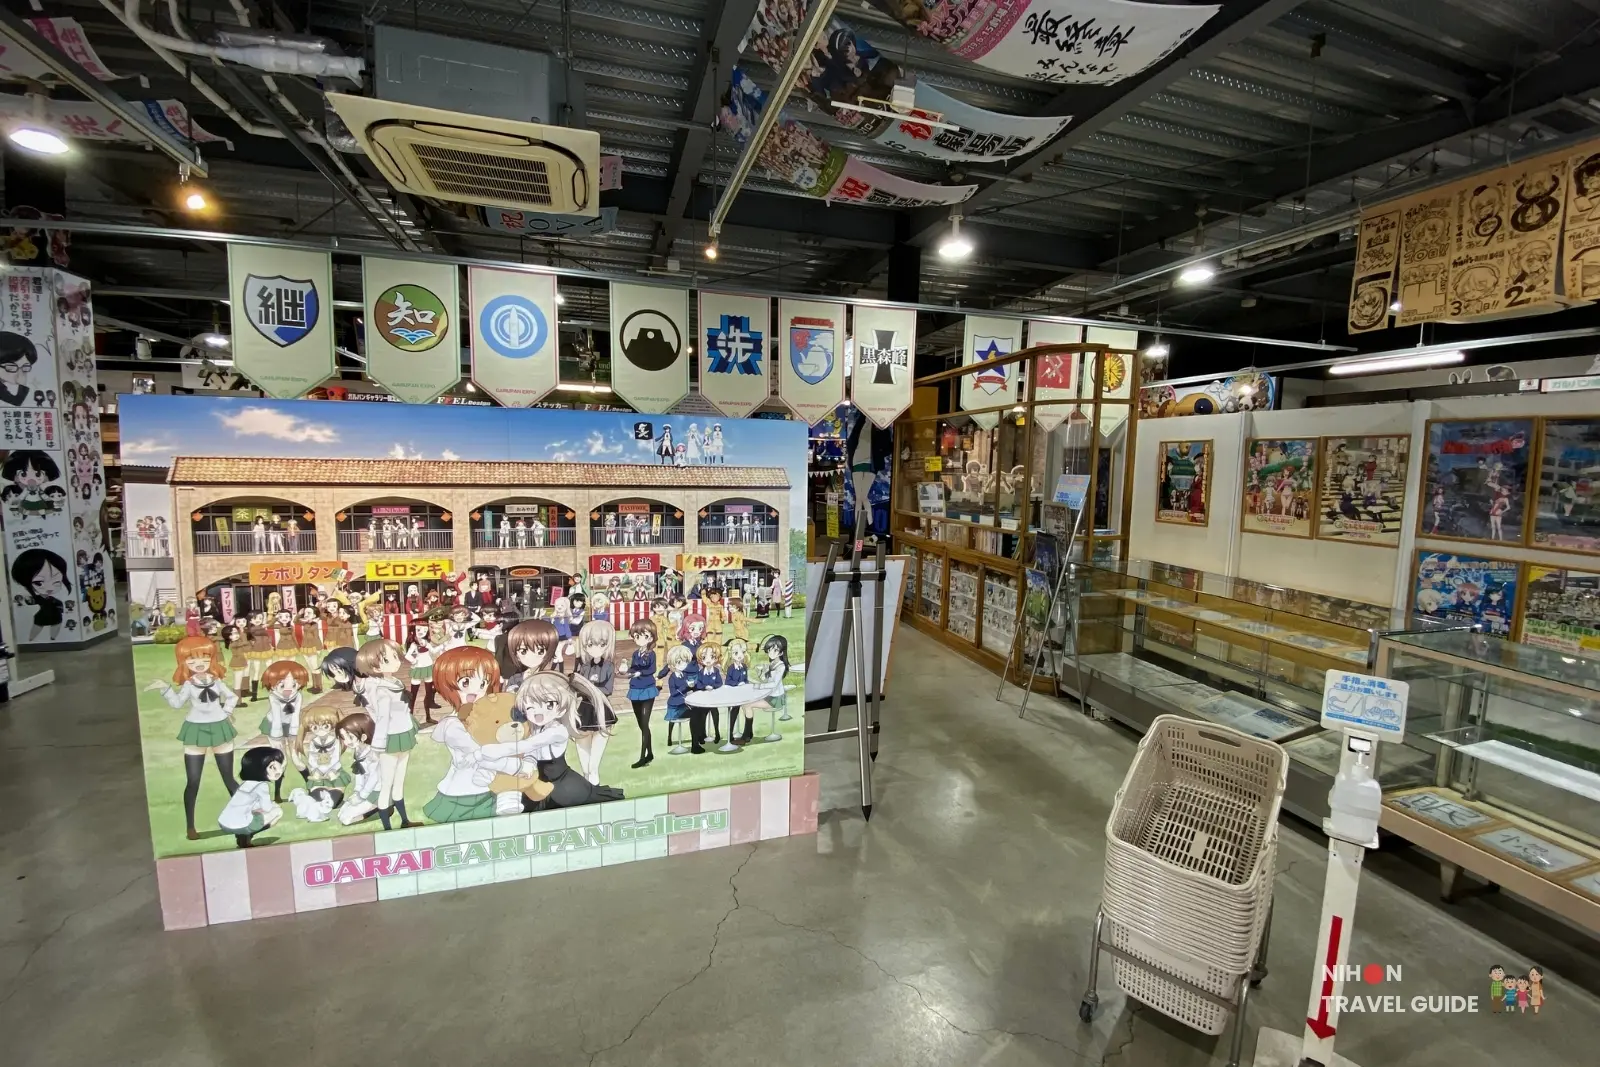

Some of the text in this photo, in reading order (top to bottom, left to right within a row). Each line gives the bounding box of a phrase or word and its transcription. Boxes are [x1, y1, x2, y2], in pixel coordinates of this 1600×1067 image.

[1022, 9, 1136, 59] 最終章
[386, 290, 437, 327] 知
[717, 325, 754, 363] 洗
[861, 346, 908, 367] 黒森峰
[375, 562, 442, 577] ピロシキ
[693, 555, 736, 569] 串カツ
[304, 808, 729, 888] OARAI GARUPAN Gallery
